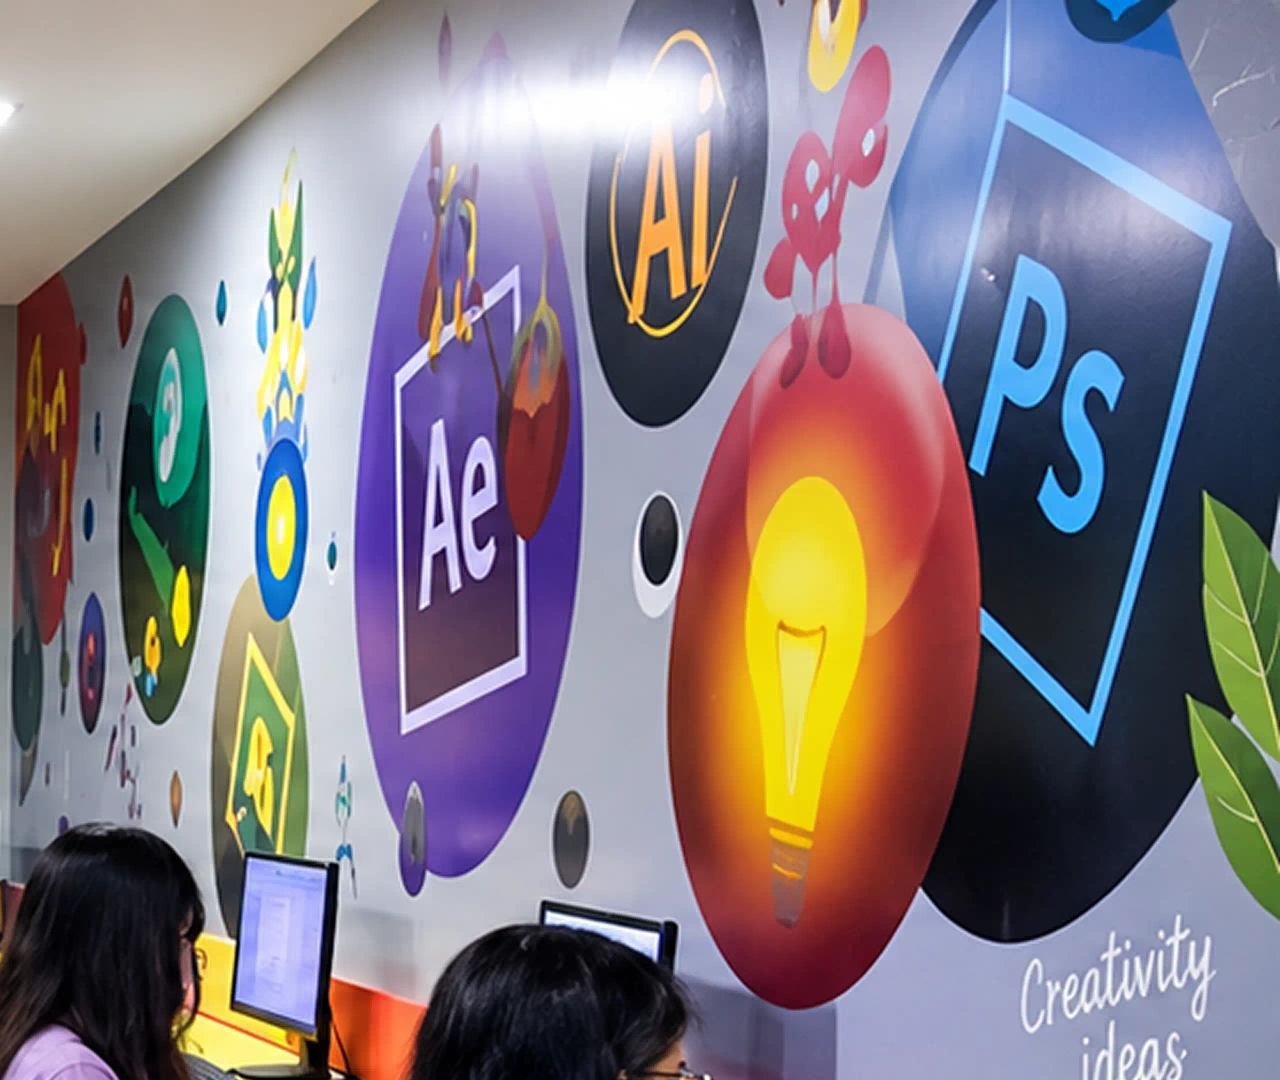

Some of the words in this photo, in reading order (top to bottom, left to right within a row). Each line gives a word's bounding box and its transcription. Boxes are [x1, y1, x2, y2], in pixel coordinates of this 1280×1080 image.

[627, 72, 714, 323] Ai
[968, 254, 1125, 534] Ps
[418, 418, 498, 611] Ae
[1021, 914, 1216, 1021] Creativity
